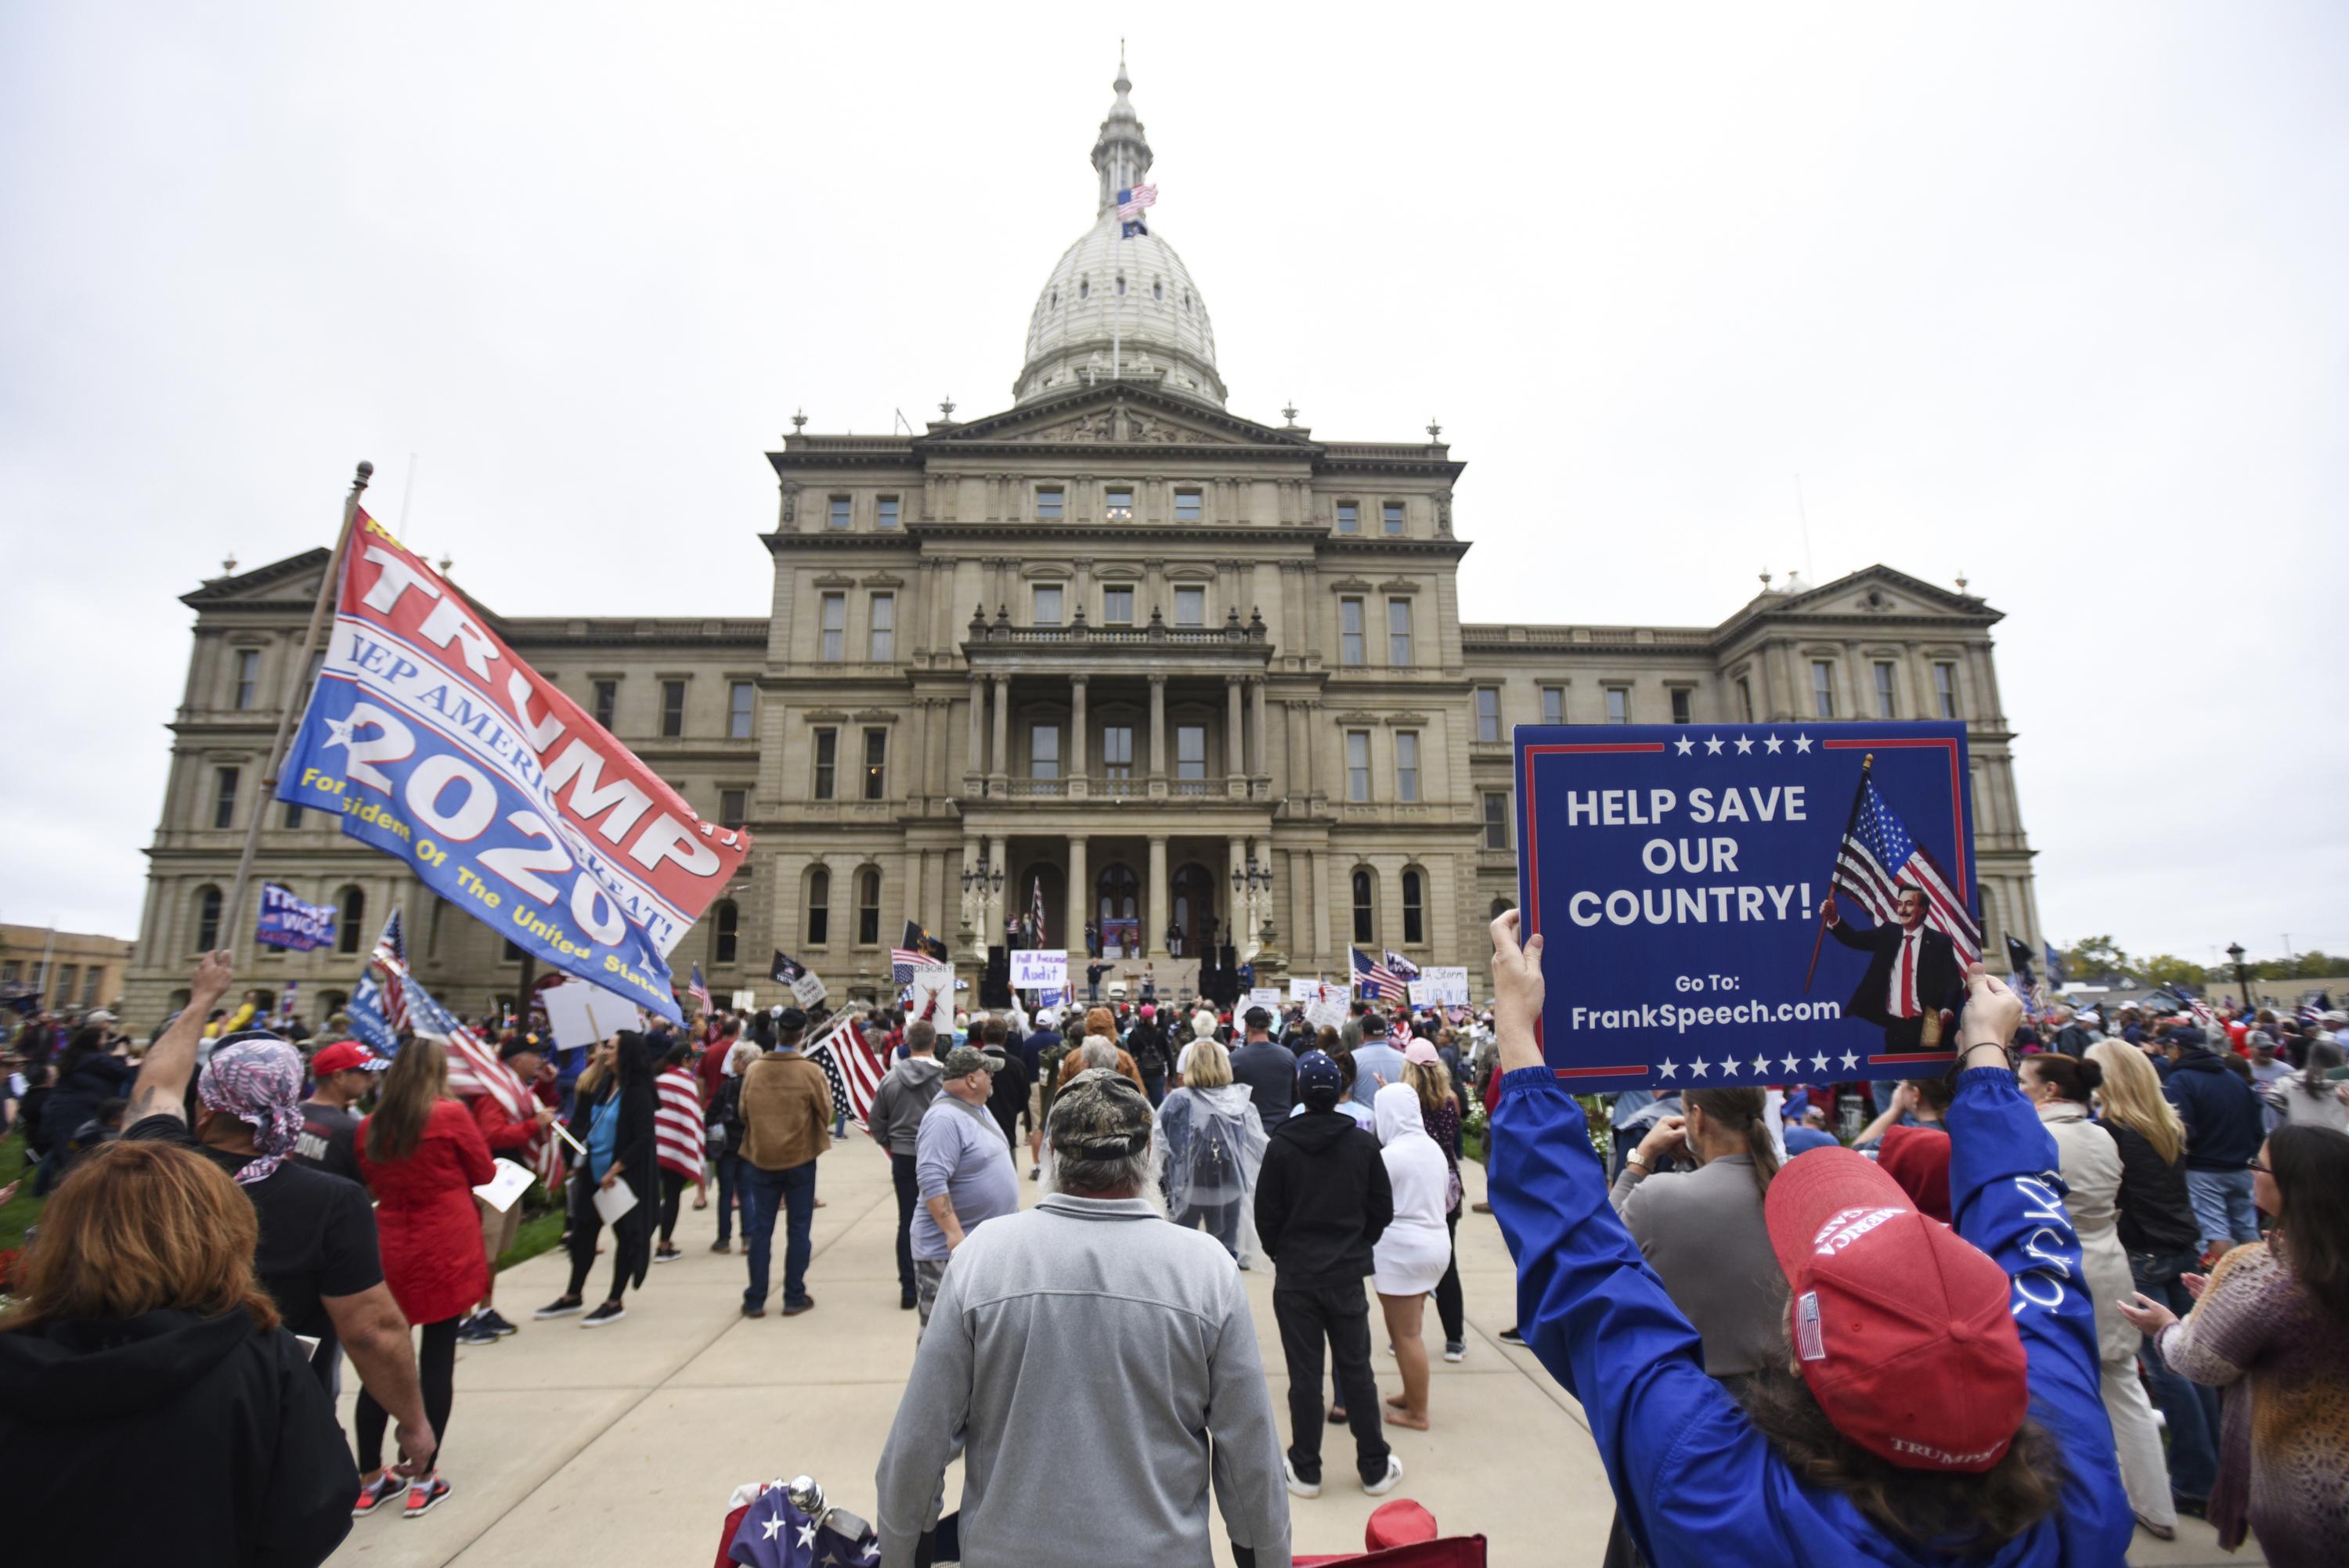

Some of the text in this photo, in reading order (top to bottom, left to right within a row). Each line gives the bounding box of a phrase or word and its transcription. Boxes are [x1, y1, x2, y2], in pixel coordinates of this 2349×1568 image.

[363, 545, 720, 877] TRUMP
[345, 701, 626, 946] 2020
[1568, 786, 1807, 827] HELP SAVE
[1642, 837, 1739, 874] OUR
[301, 767, 348, 795] For
[416, 838, 448, 868] Of
[457, 866, 501, 909] The
[513, 904, 590, 960] United
[603, 954, 670, 1004] States
[1569, 882, 1812, 927] COUNTRY!
[1022, 966, 1057, 981] Audit
[1434, 968, 1465, 980] Storm
[1675, 974, 1741, 993] Go To:
[1572, 1000, 1842, 1034] FrankSpeech.com
